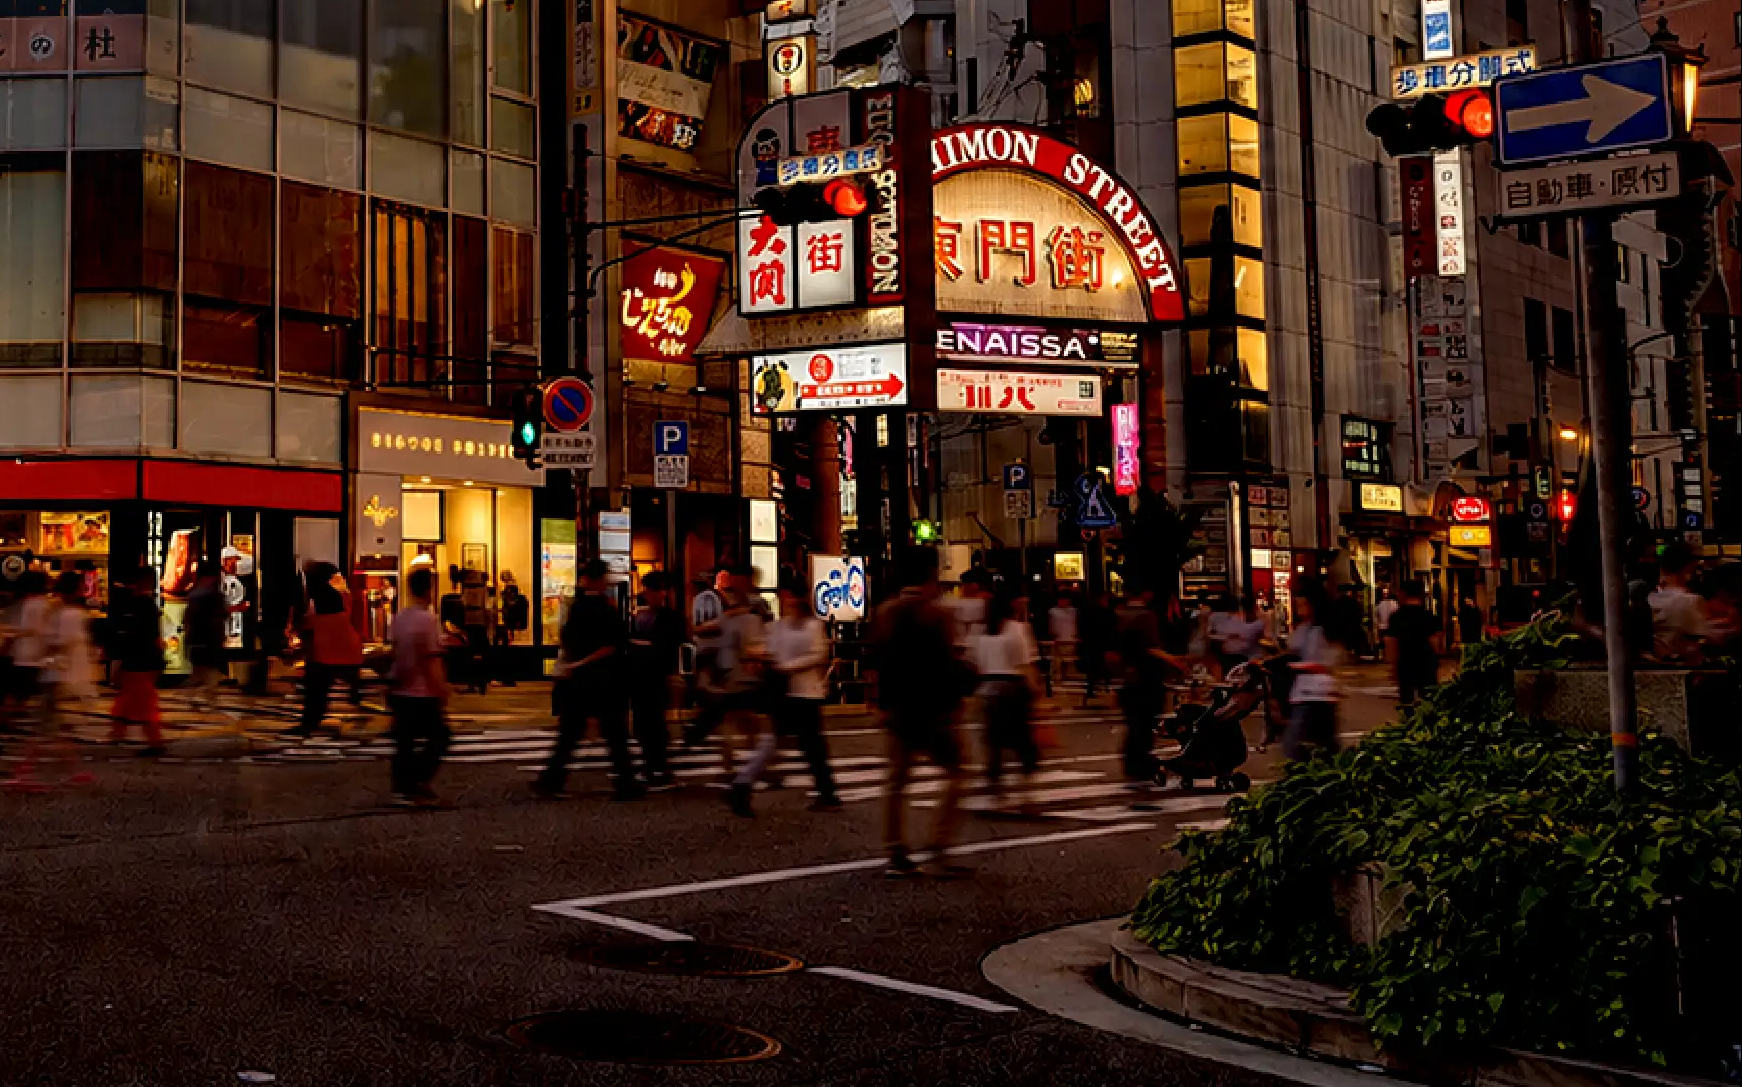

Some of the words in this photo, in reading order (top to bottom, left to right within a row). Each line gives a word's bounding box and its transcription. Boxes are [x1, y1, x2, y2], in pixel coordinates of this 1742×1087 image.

[1064, 153, 1177, 292] STREET
[662, 426, 681, 451] P
[1010, 467, 1025, 487] P
